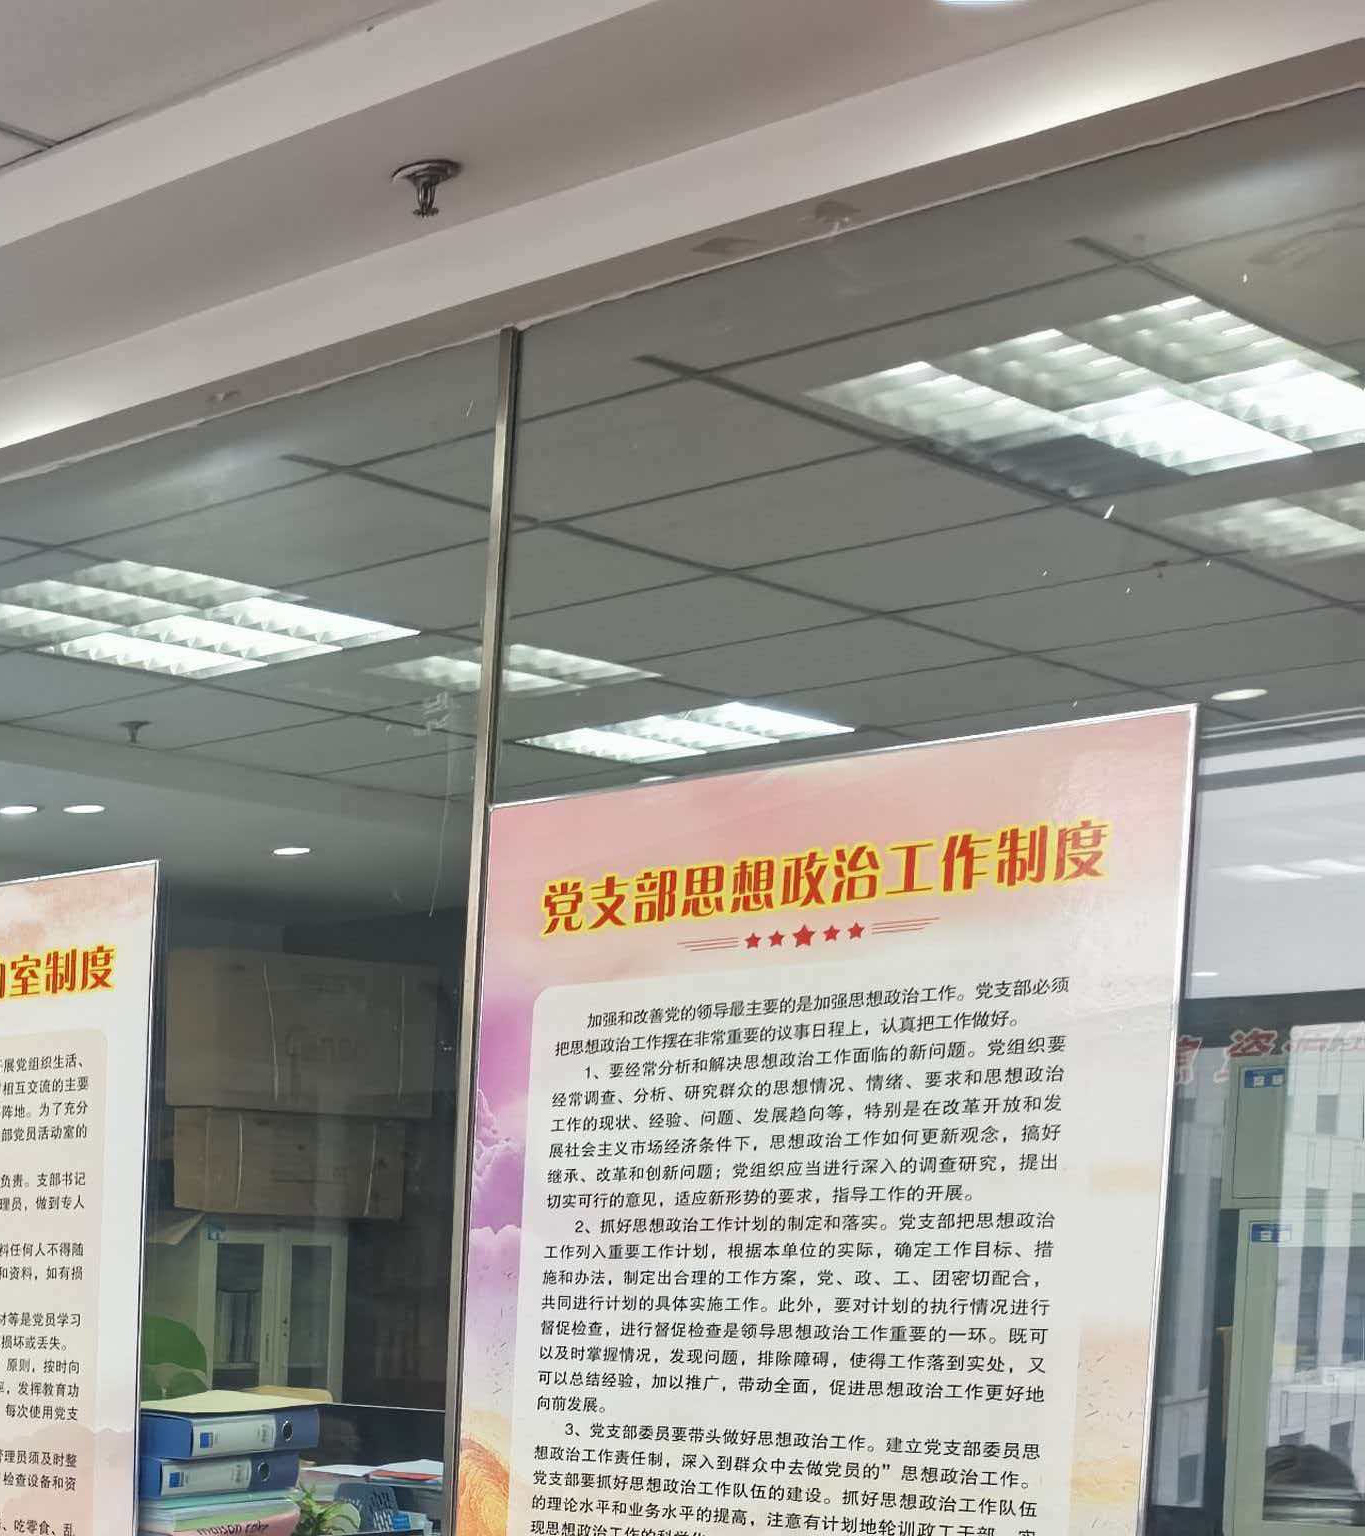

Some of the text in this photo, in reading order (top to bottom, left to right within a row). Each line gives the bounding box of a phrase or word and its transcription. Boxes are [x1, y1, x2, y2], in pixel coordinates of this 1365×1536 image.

[539, 814, 1110, 937] 党支部思想政治工作制度
[535, 1393, 607, 1414] 向前发展。
